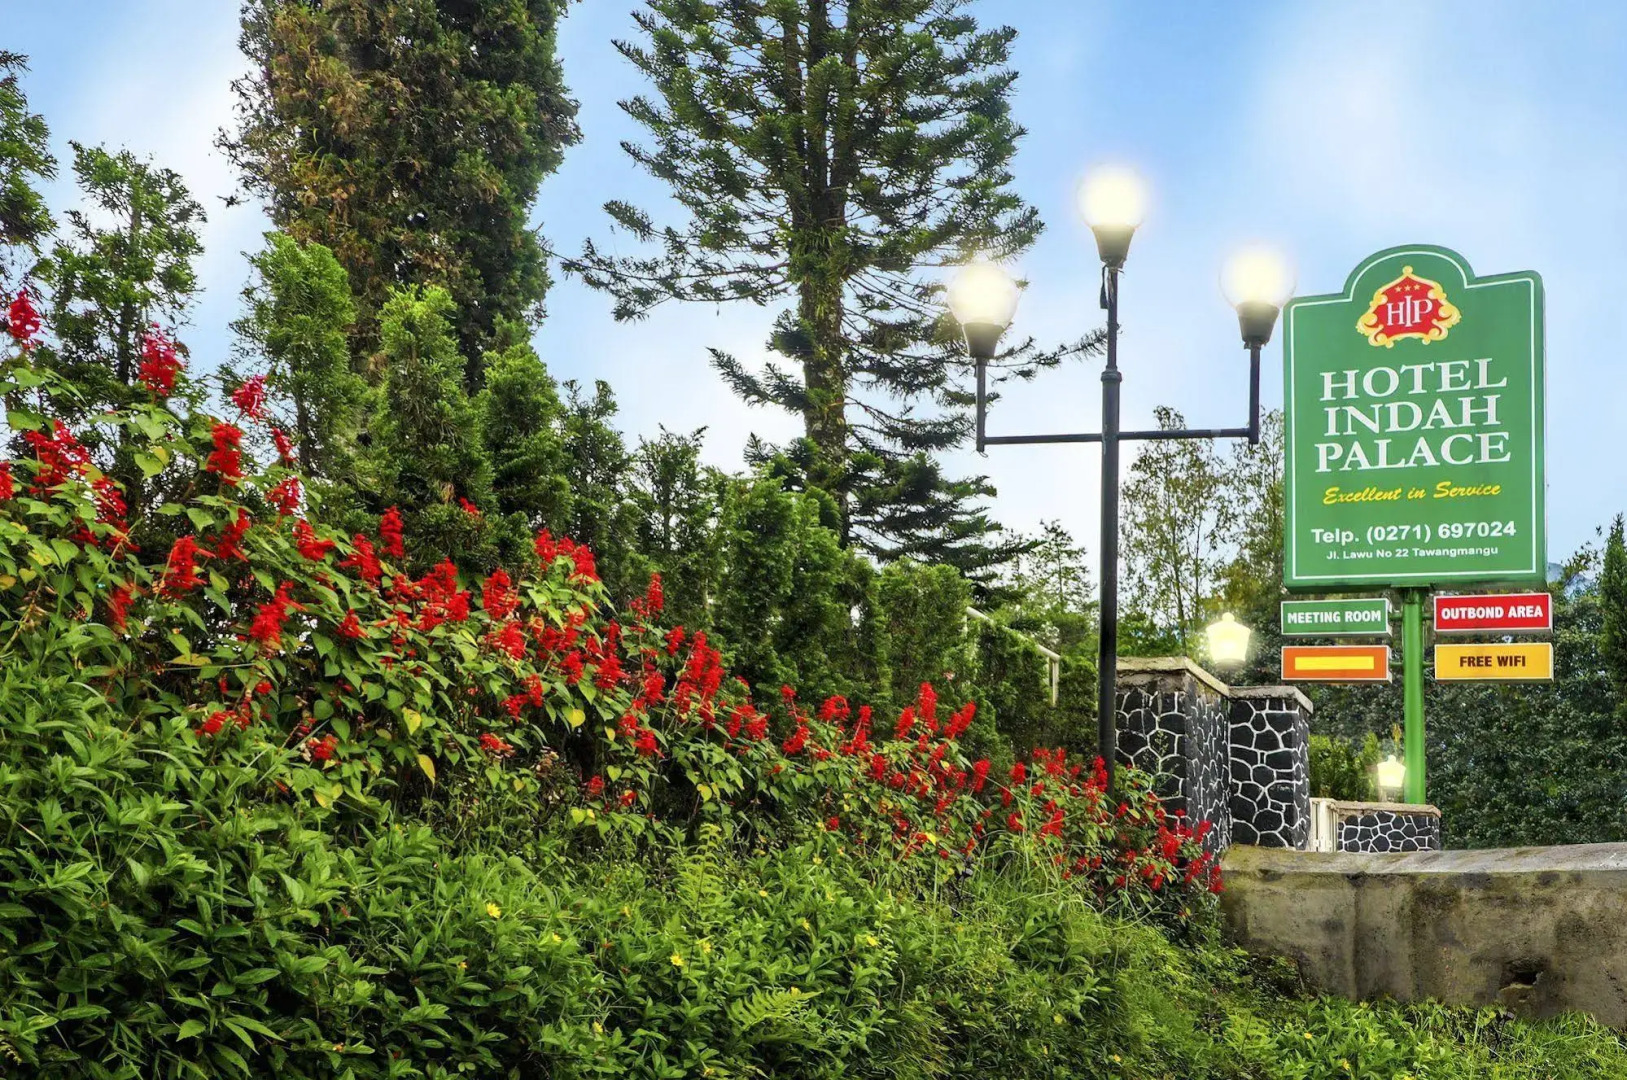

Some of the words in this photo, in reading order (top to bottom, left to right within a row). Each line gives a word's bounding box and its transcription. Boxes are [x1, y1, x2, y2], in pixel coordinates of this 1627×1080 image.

[1319, 358, 1508, 401] HOTEL
[1323, 394, 1501, 437] INDAH
[1314, 431, 1511, 473] PALACE
[1323, 486, 1402, 505] Excellent
[1407, 487, 1426, 500] in
[1433, 481, 1501, 498] Service
[1311, 527, 1359, 546] Telp.
[1366, 524, 1431, 545] (0271)
[1438, 521, 1517, 540] 697024
[1326, 550, 1340, 560] Jl.
[1343, 550, 1373, 560] Lawu
[1376, 549, 1392, 559] No
[1395, 548, 1409, 558] 22
[1412, 546, 1498, 558] Tawangmangu
[1287, 611, 1341, 624] MEETING
[1344, 610, 1382, 623] ROOM
[1441, 606, 1504, 620] OUTBOND
[1507, 605, 1543, 618] AREA
[1459, 655, 1493, 667] FREE
[1497, 655, 1527, 667] WIFI
